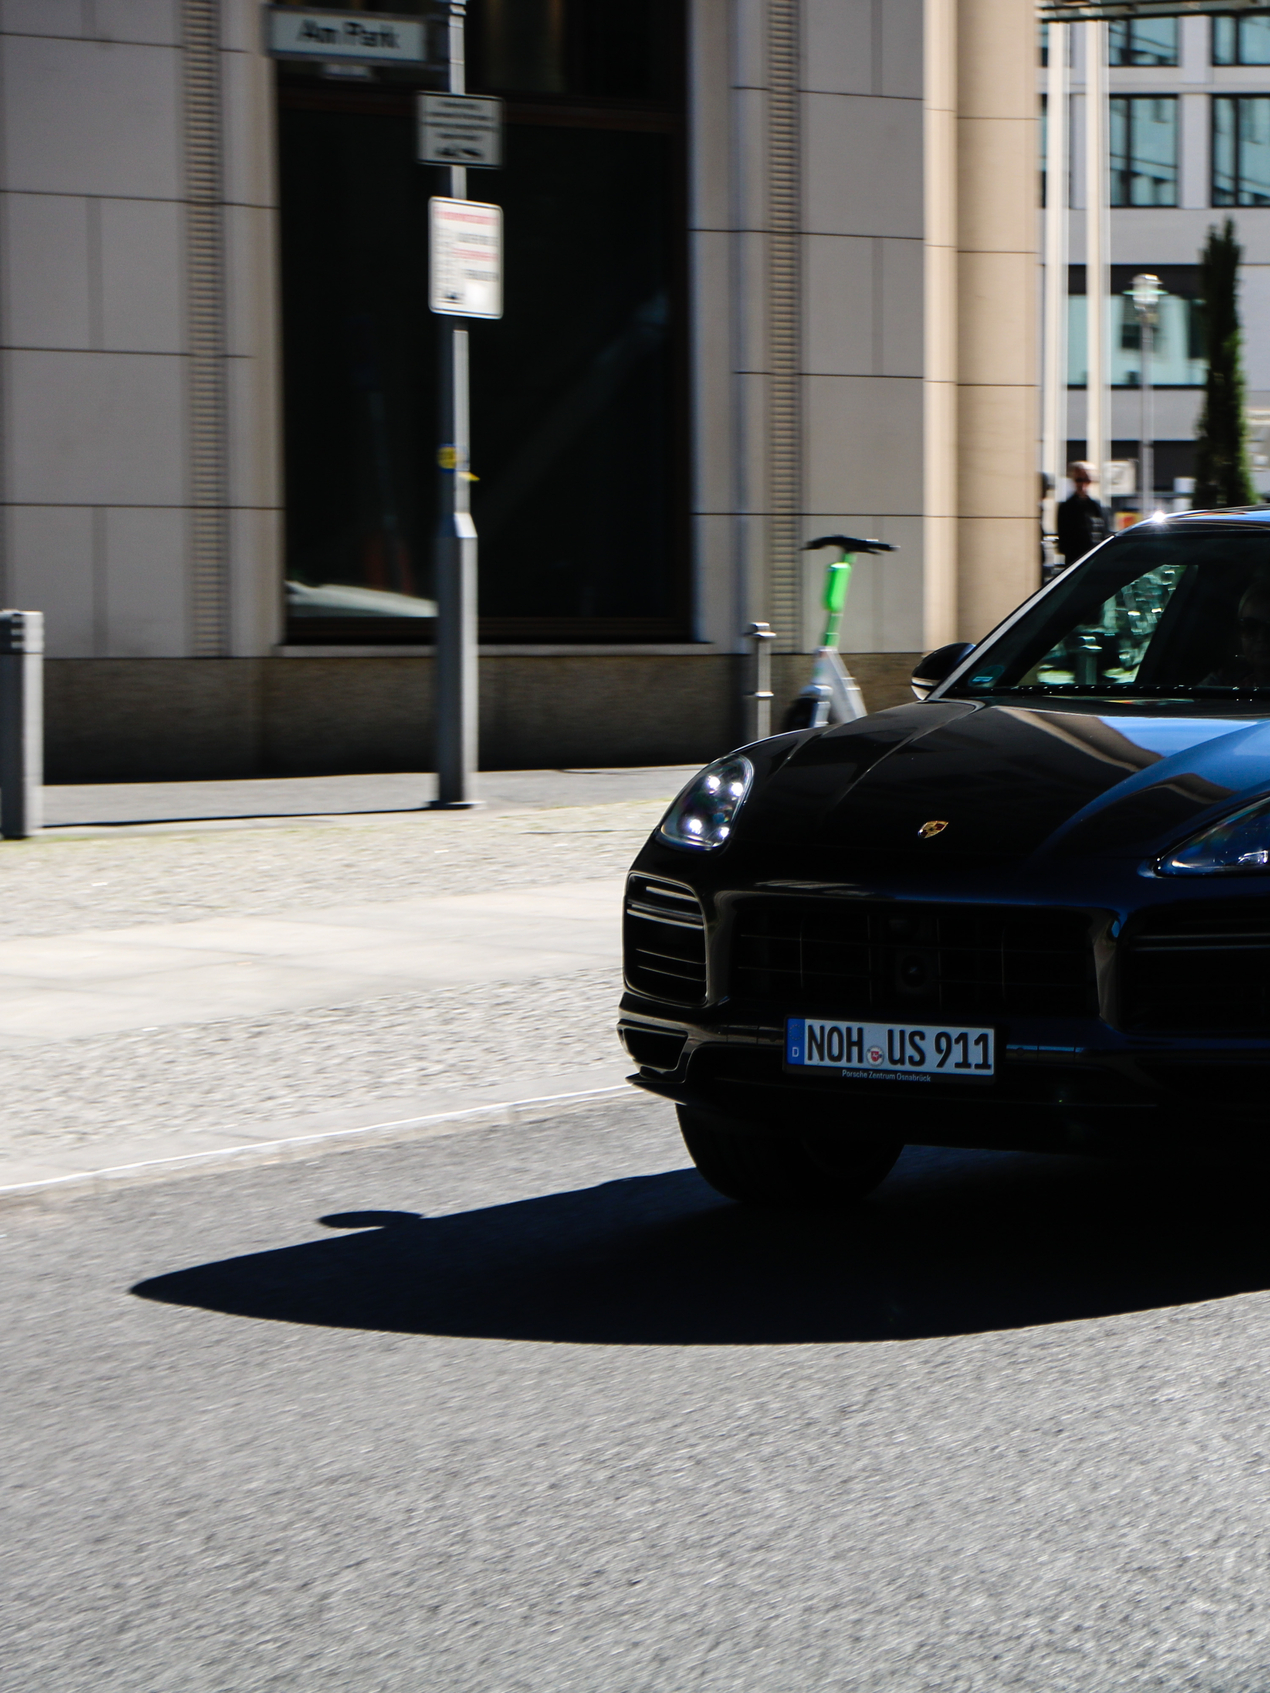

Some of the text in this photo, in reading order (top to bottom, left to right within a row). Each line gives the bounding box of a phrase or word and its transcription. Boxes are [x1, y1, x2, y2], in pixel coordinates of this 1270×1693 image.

[791, 1046, 800, 1058] D
[806, 1024, 993, 1071] NOH US 911
[841, 1069, 868, 1080] Porsche
[868, 1071, 896, 1081] Zentrum
